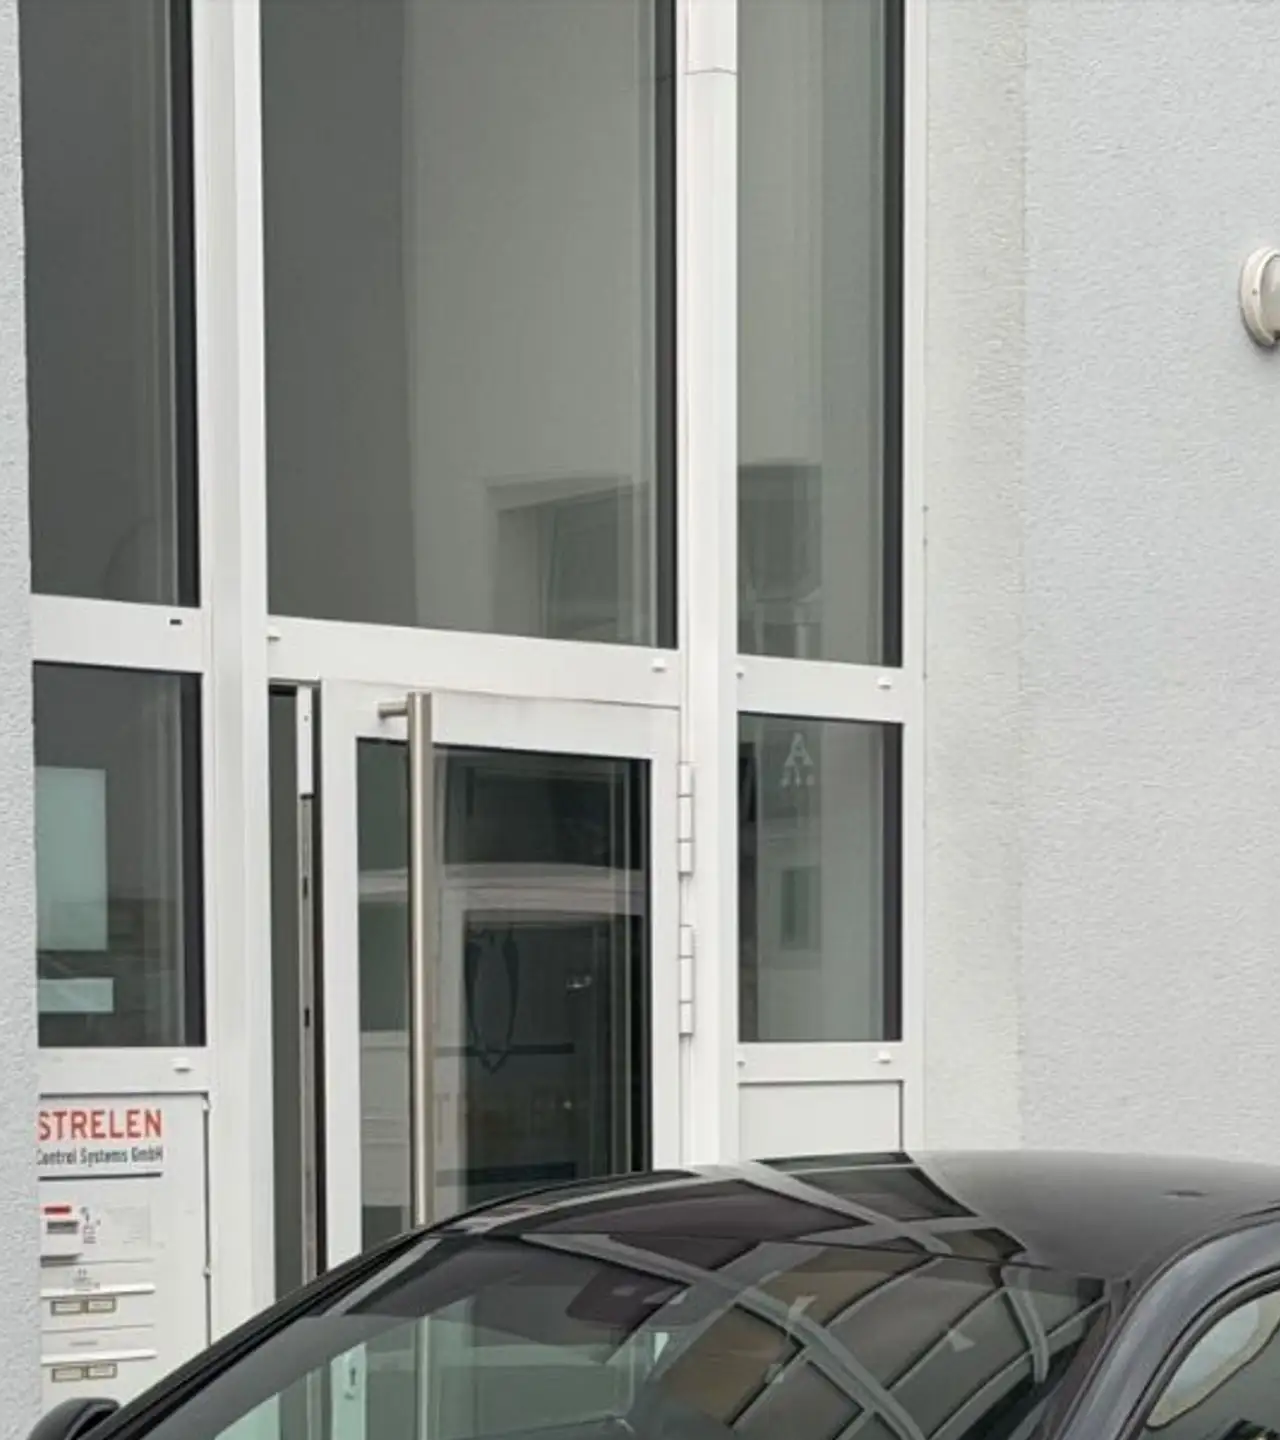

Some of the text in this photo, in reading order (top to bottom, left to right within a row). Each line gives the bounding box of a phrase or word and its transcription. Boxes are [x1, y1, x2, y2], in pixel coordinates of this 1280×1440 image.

[37, 1107, 162, 1140] STRELEN
[80, 1146, 128, 1168] Systems
[131, 1144, 163, 1162] GmbH
